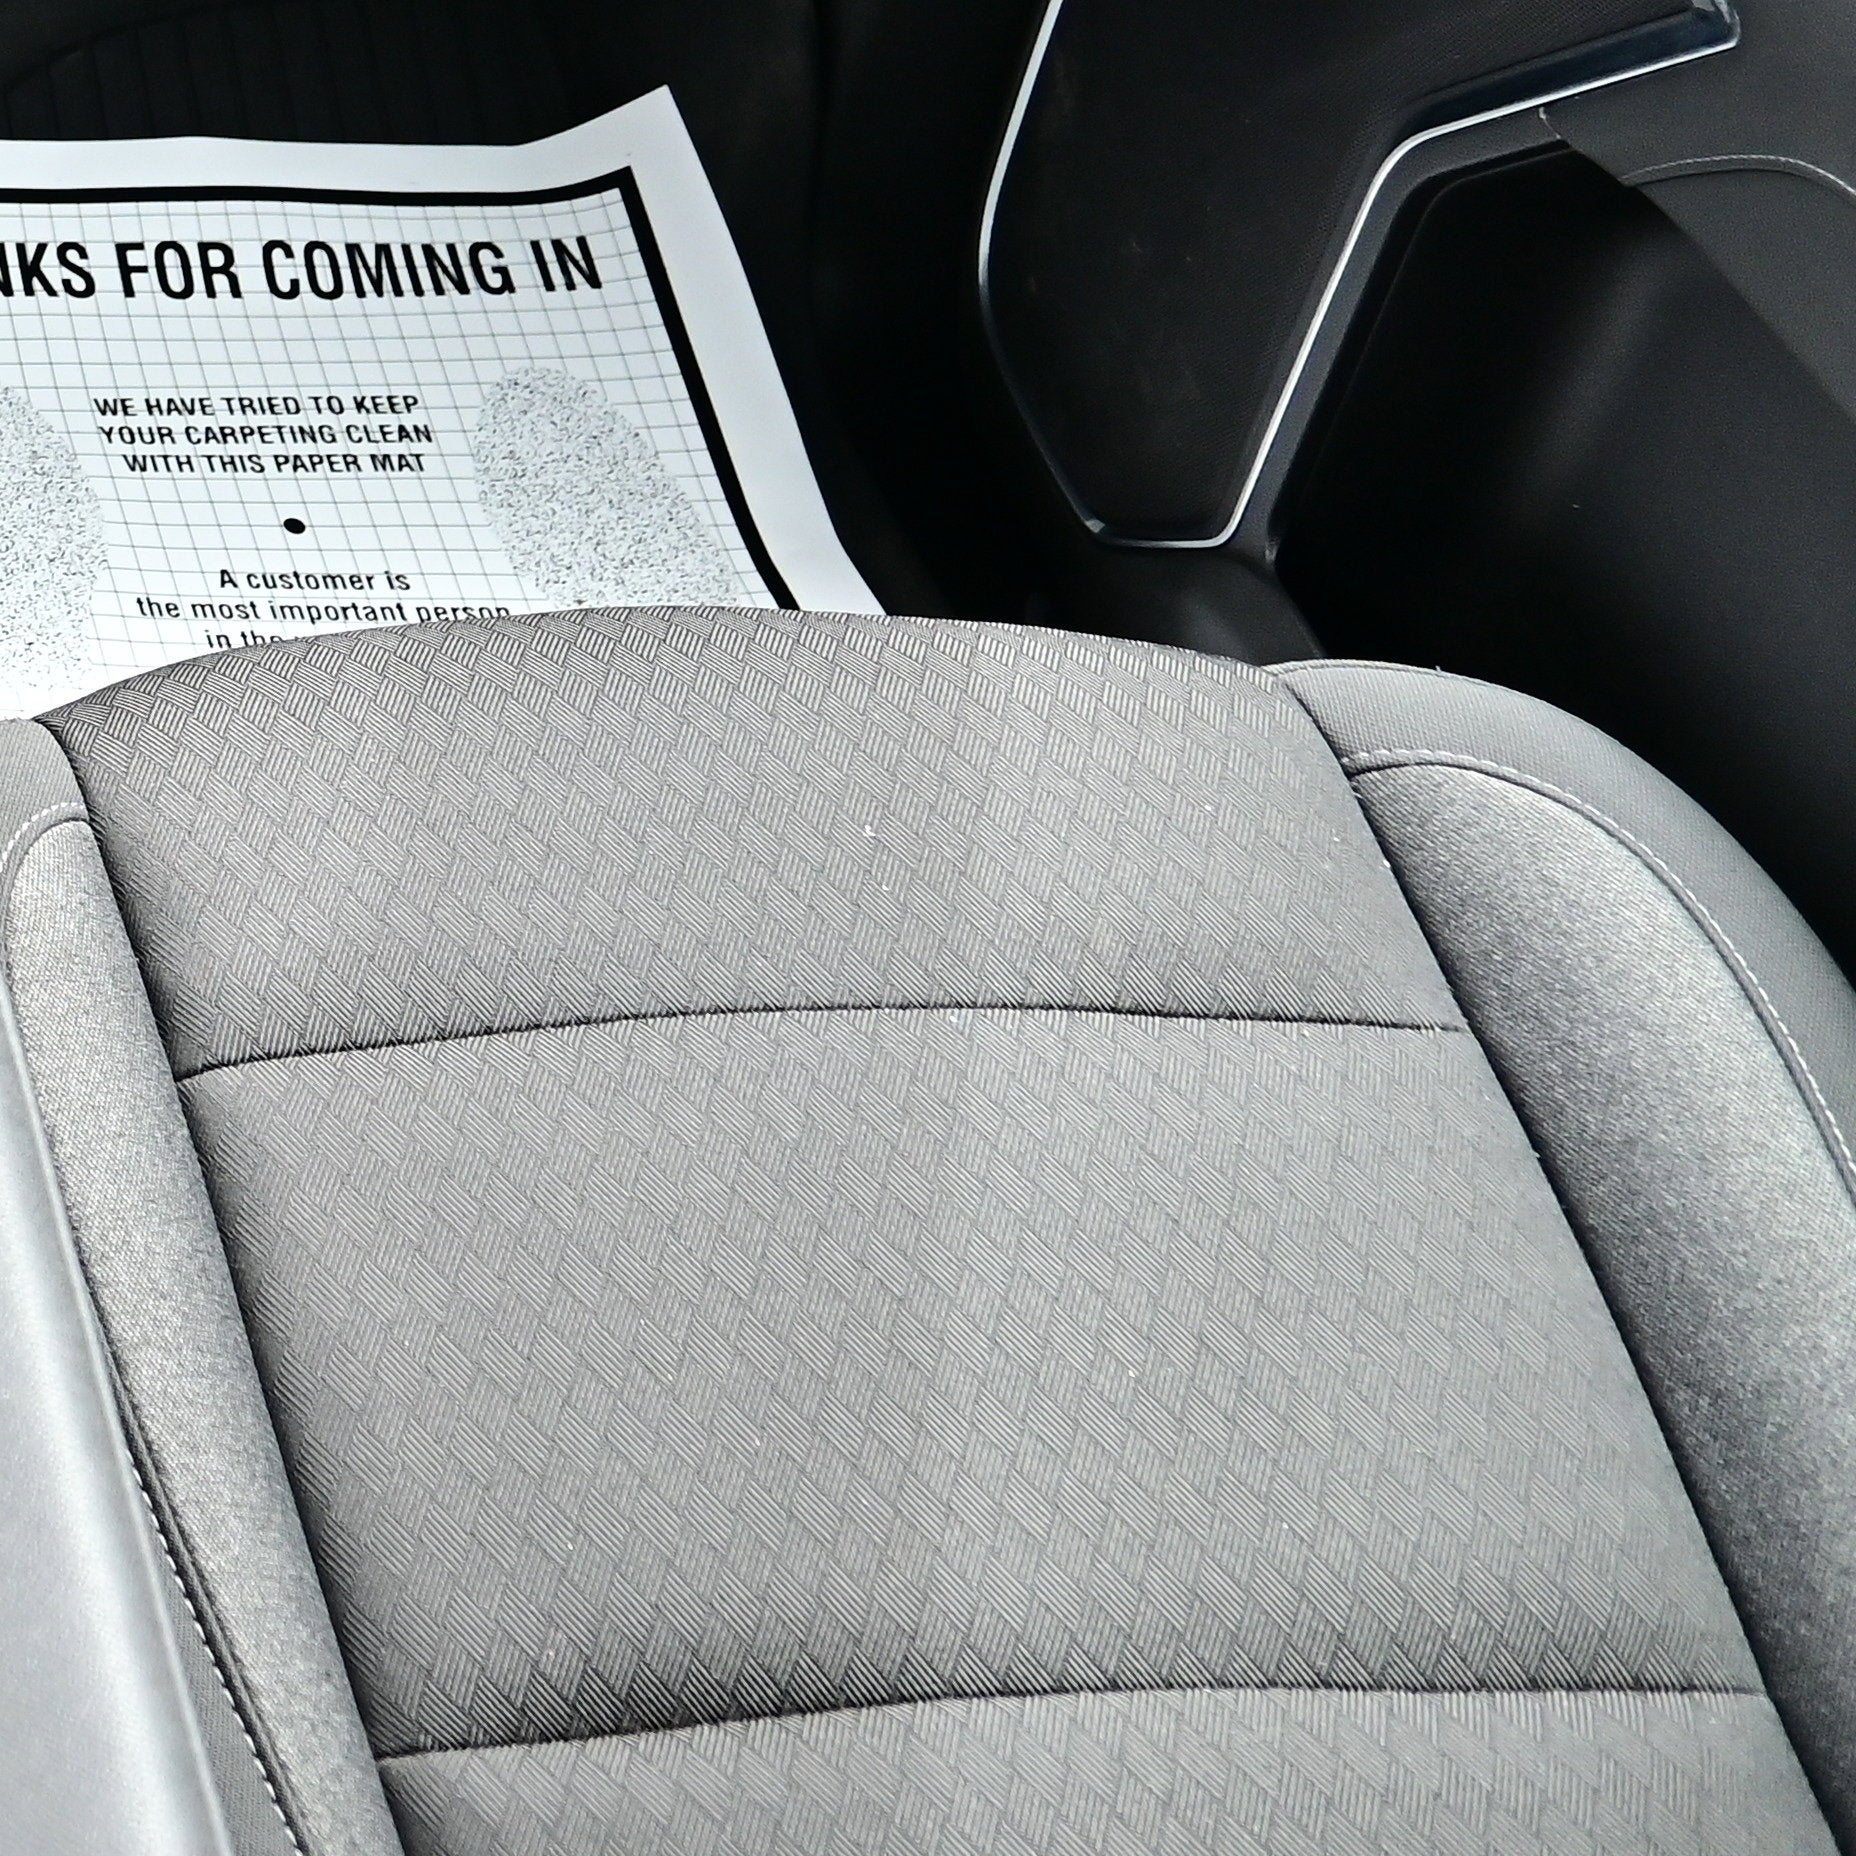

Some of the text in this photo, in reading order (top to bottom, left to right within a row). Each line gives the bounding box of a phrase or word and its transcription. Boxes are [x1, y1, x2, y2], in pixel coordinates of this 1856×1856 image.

[114, 240, 243, 300] FOR
[262, 240, 517, 300] COMING
[530, 235, 603, 293] IN
[93, 394, 420, 417] WE HAVE TRIED TO KEEP
[97, 423, 433, 445] YOUR CARPETING CLEAN
[122, 453, 426, 474] WITH THIS PAPER MAT
[219, 569, 411, 591] A customer is
[135, 597, 510, 624] the most important person
[204, 629, 232, 648] in
